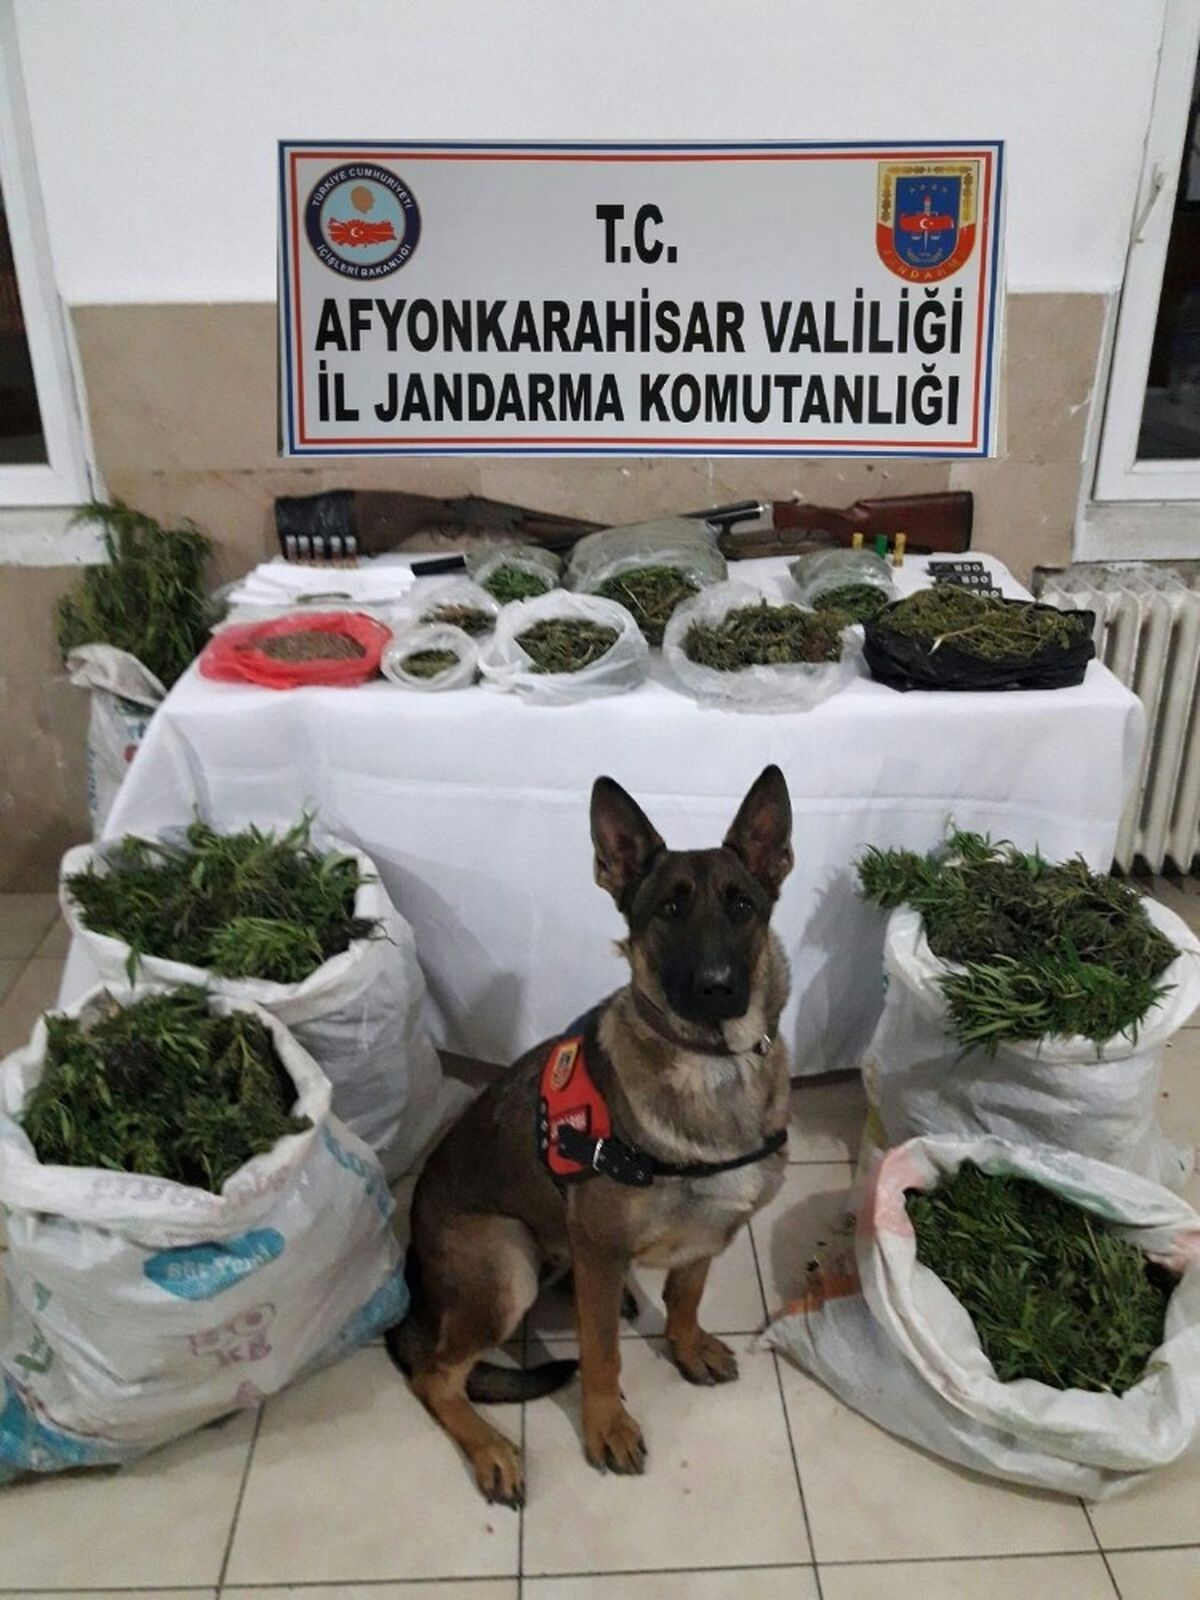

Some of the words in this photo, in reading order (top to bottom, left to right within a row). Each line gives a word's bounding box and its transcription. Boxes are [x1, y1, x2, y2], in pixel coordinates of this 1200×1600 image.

[312, 170, 346, 206] TÜRKİYE
[348, 167, 414, 209] CUMHURİYETİ
[317, 244, 358, 275] İÇİŞLERİ
[596, 203, 678, 264] T.C.
[313, 287, 745, 353] AFYONKARAHİSAR
[760, 286, 963, 355] VALİLİĞİ
[318, 359, 360, 422] İL
[374, 372, 625, 423] JANDARMA
[640, 362, 960, 426] KOMUTANLIĞI
